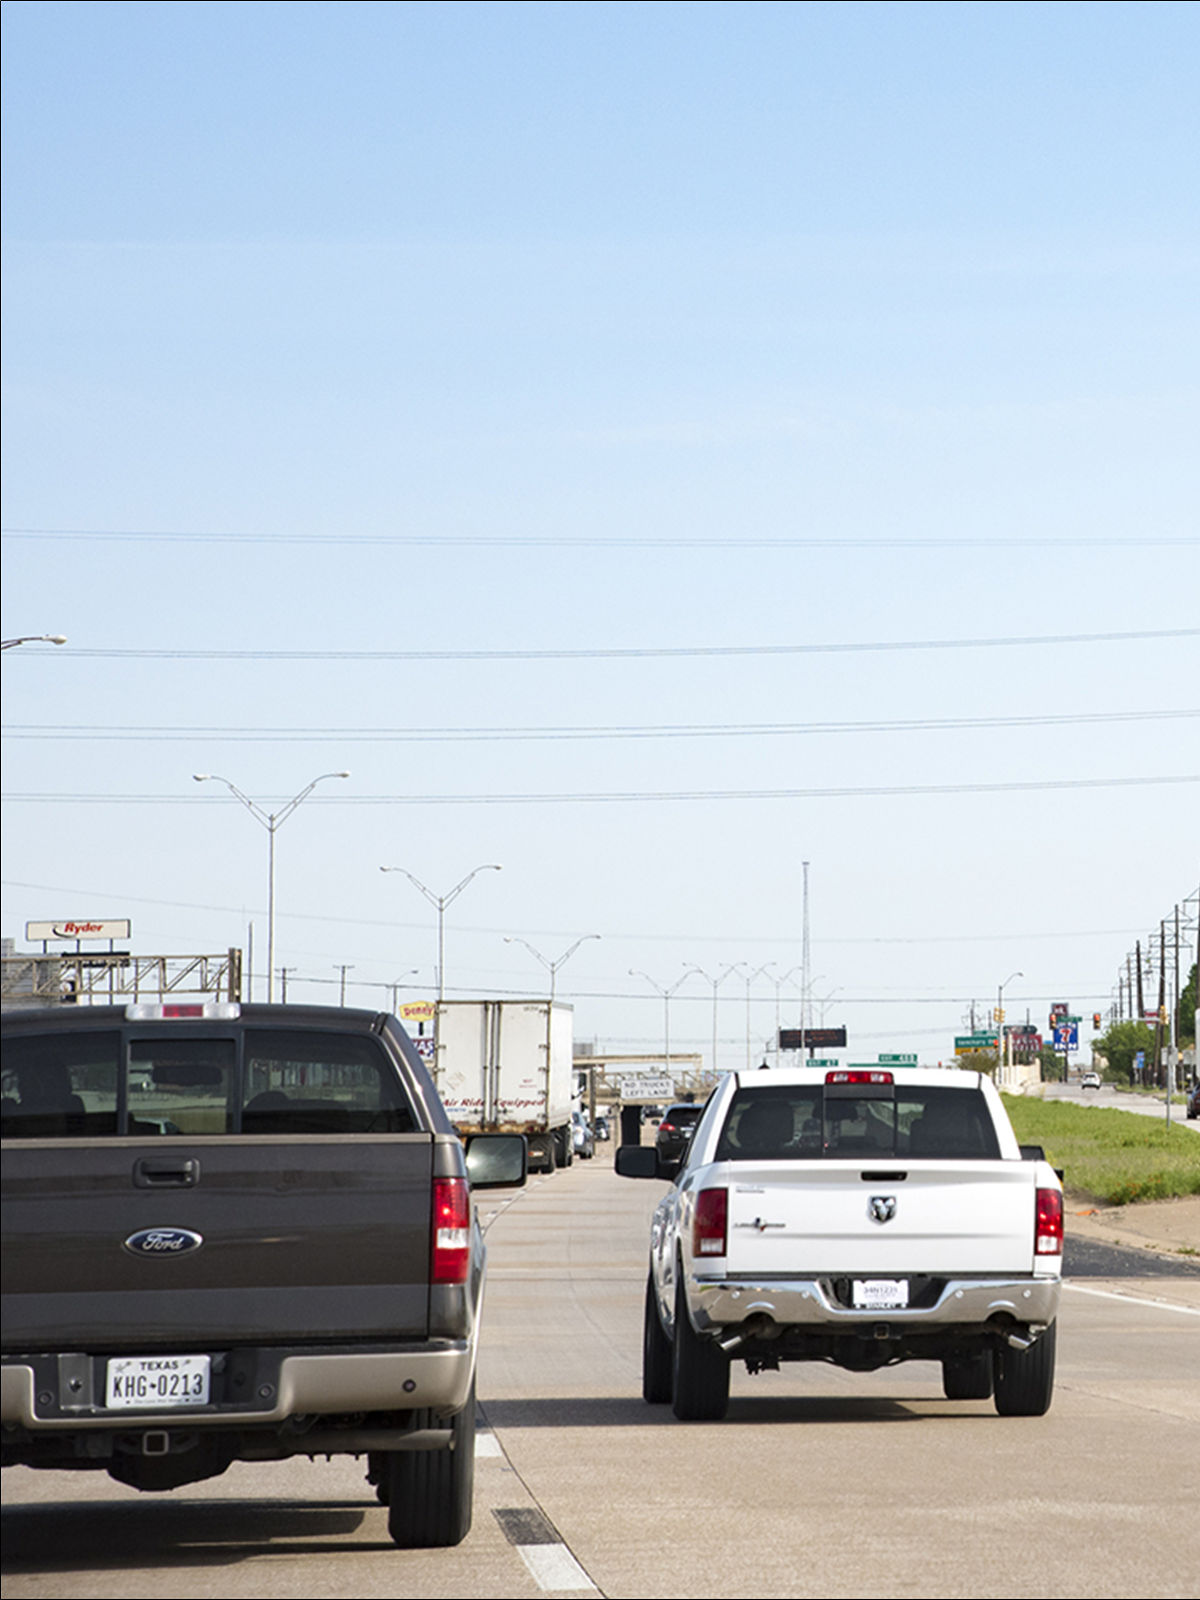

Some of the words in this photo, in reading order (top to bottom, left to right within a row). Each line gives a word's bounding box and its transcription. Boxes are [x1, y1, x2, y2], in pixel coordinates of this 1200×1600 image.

[64, 922, 104, 935] Ryder
[442, 1098, 459, 1106] Air
[142, 1232, 185, 1250] Ford
[140, 1360, 179, 1371] TEXAS
